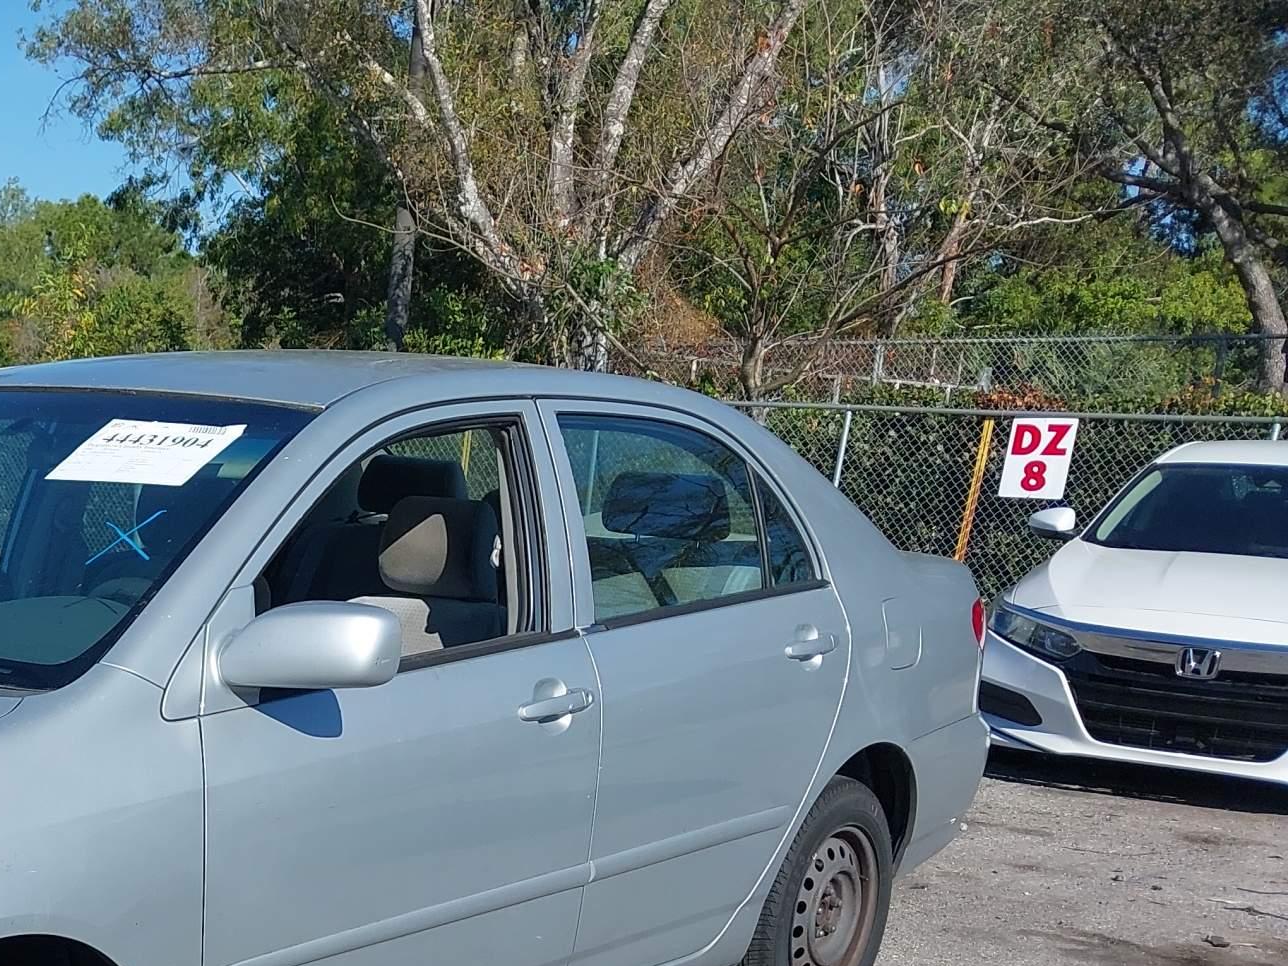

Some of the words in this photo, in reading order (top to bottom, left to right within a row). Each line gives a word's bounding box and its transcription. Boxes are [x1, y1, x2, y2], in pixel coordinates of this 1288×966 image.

[102, 433, 214, 449] 44431904
[1010, 423, 1073, 456] DZ
[1020, 460, 1047, 492] 8
